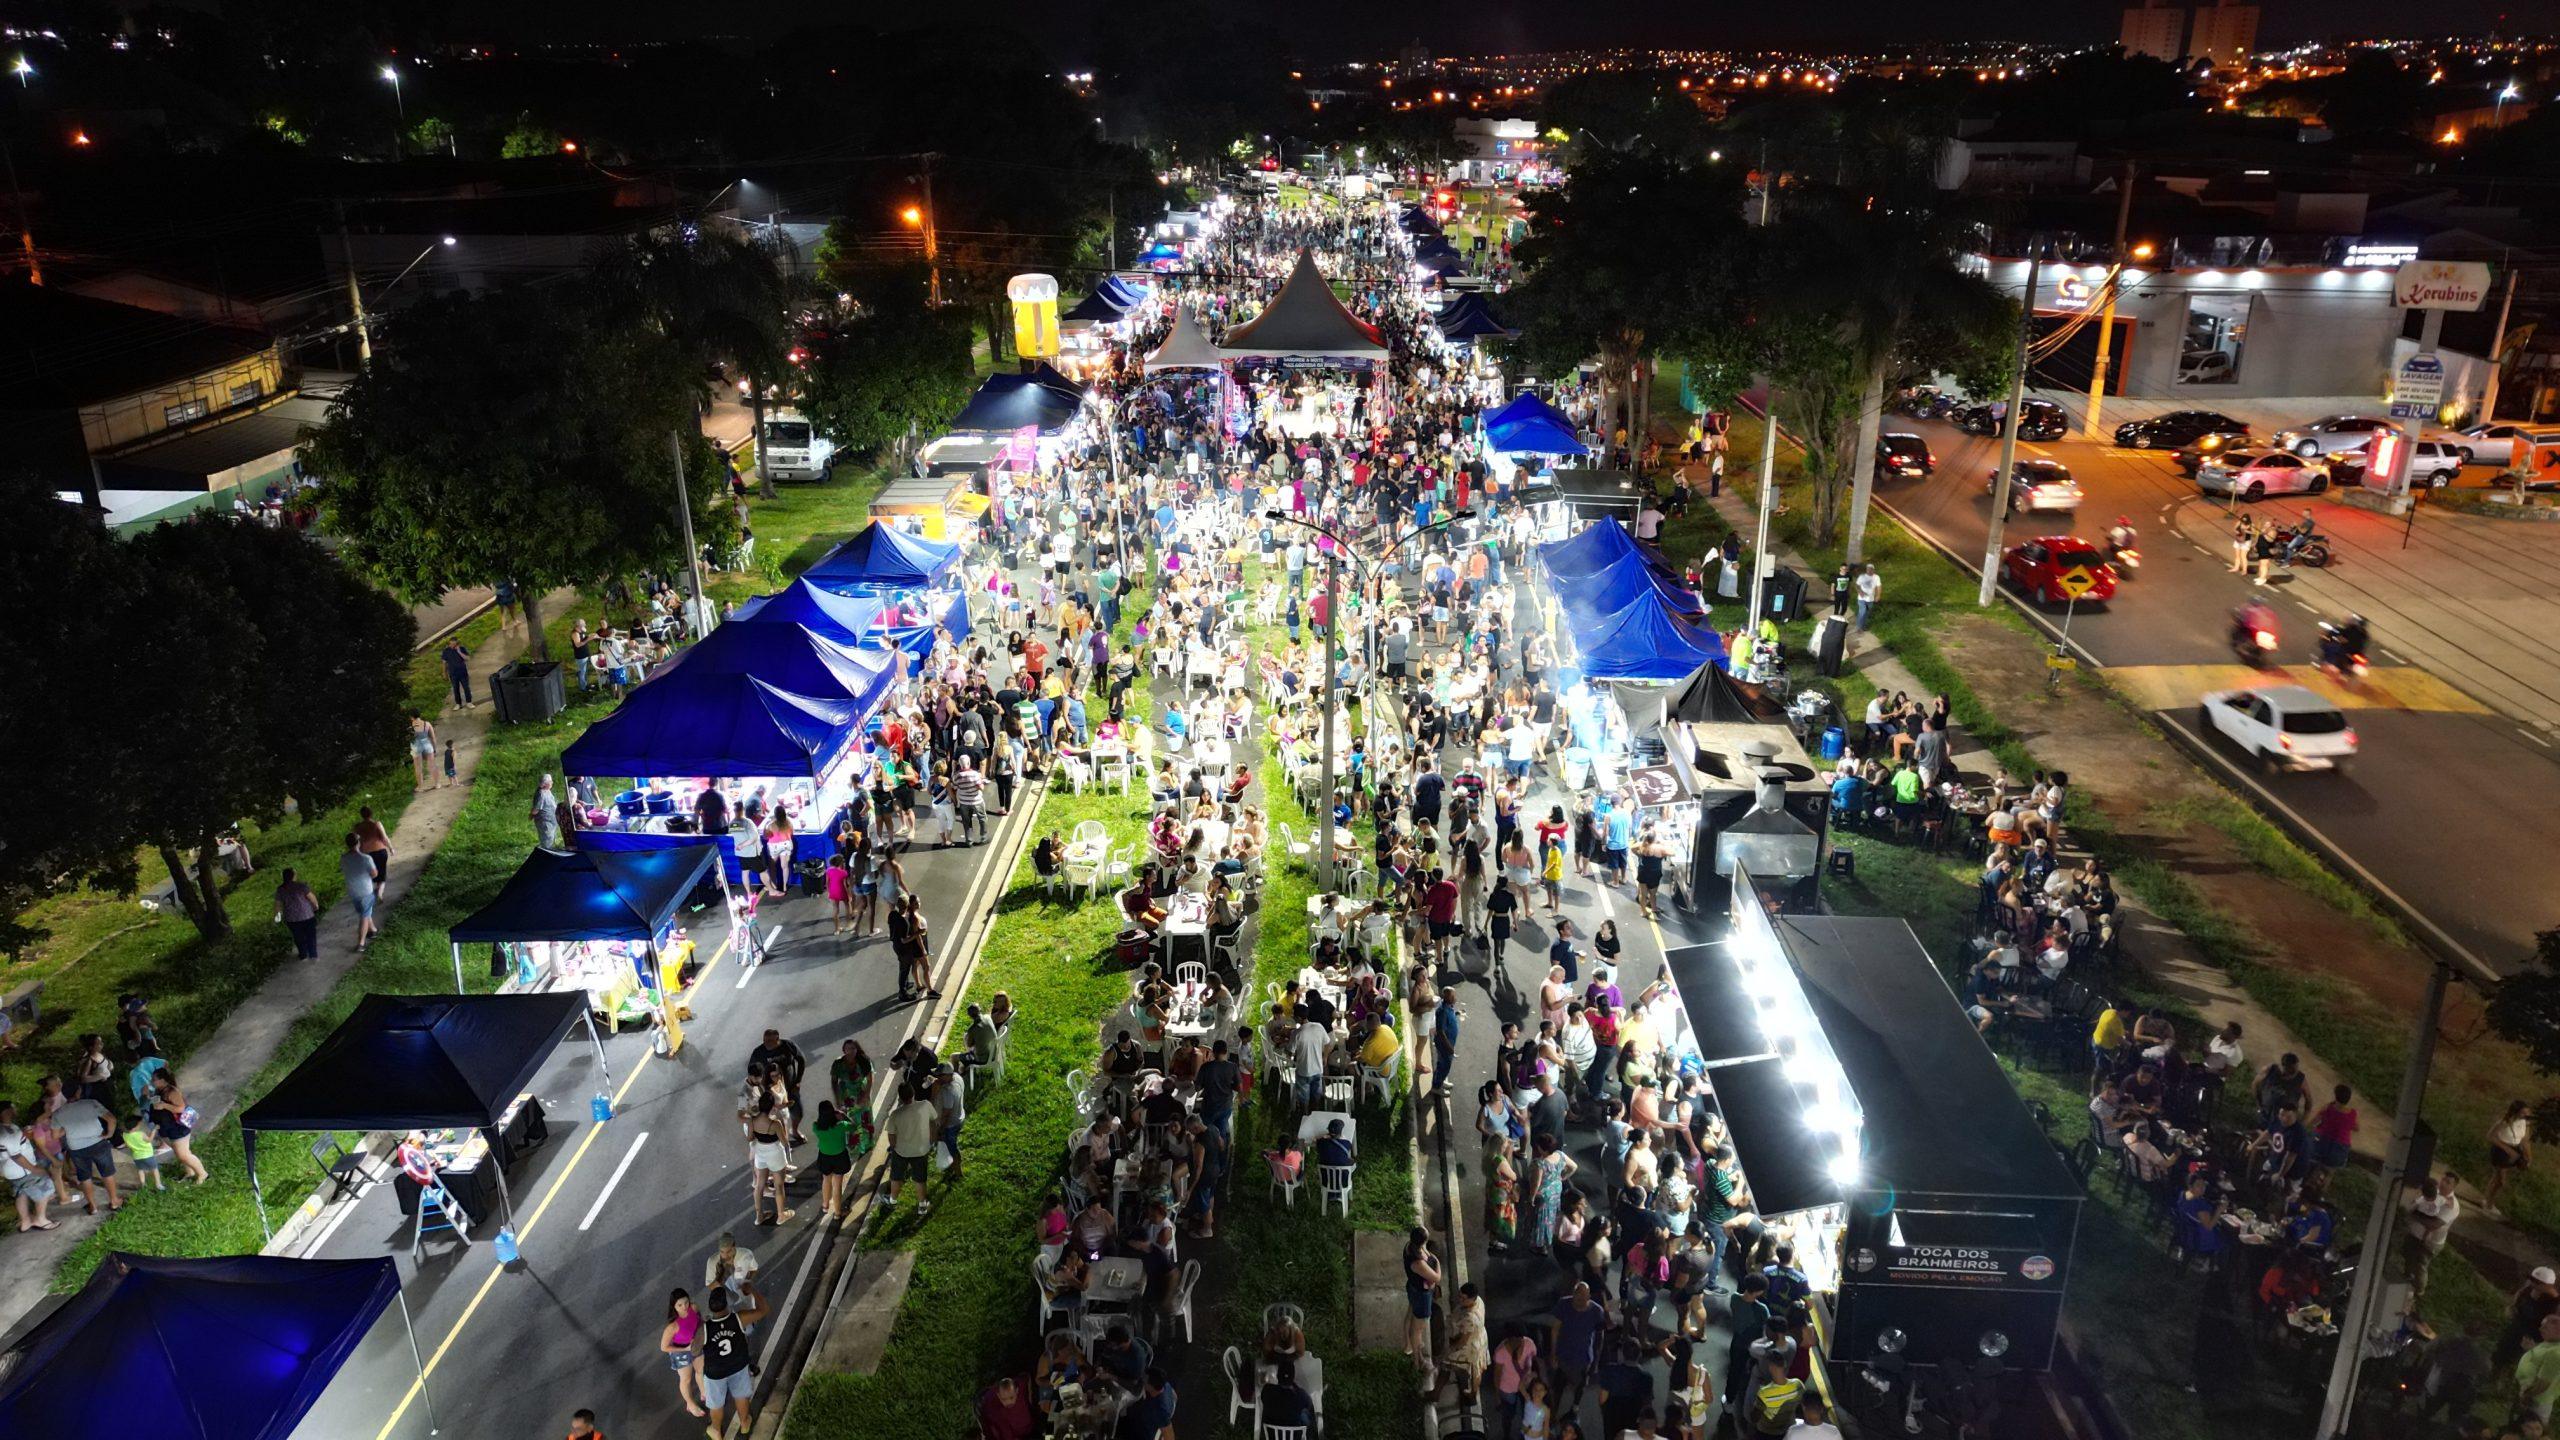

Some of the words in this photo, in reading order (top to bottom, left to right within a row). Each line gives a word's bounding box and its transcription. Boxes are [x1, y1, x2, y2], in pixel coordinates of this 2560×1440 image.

[2400, 283, 2478, 304] Kerubins
[1912, 1248, 1951, 1259] TOCA
[1957, 1250, 1990, 1259] DOS
[1898, 1257, 2000, 1270] BRAHMEIROS
[1889, 1272, 1929, 1280] MOVIDO
[1931, 1273, 1956, 1281] PELA
[1958, 1273, 2003, 1283] EMOÇÃO
[718, 1339, 732, 1356] 3
